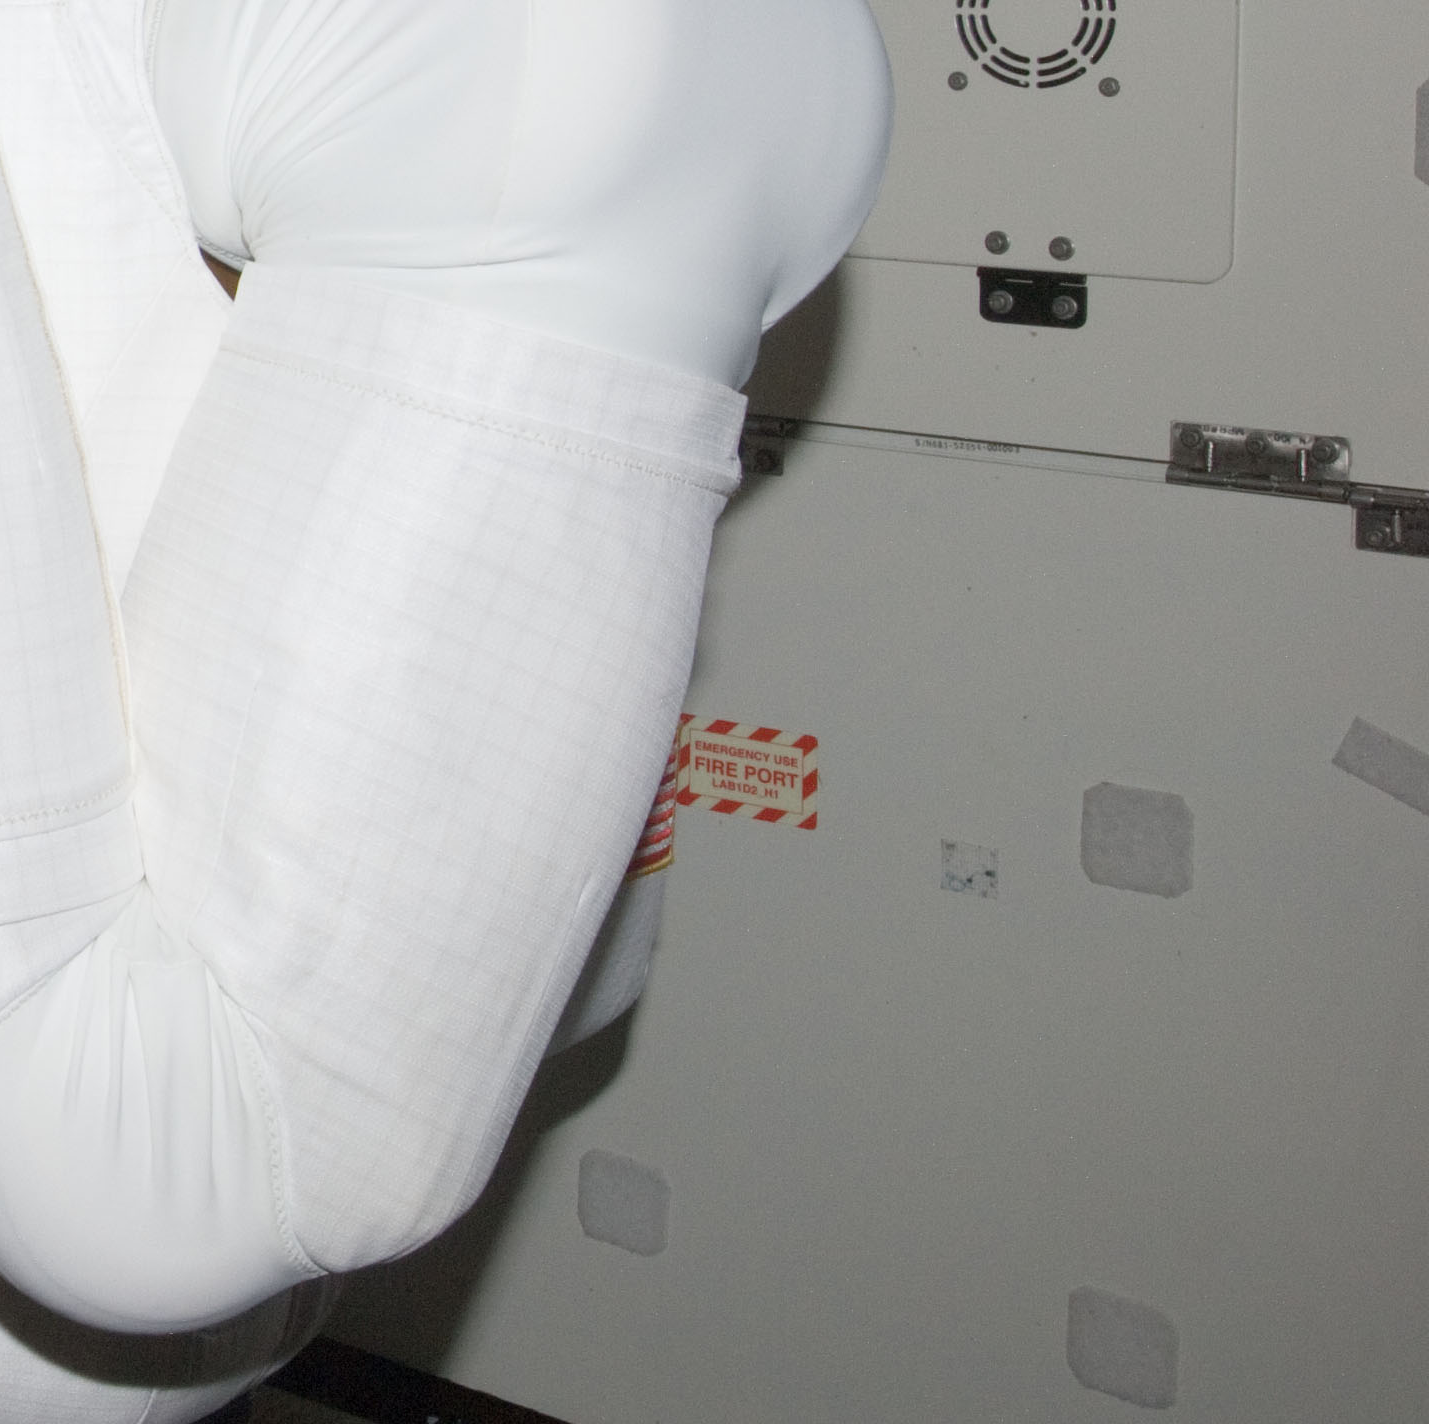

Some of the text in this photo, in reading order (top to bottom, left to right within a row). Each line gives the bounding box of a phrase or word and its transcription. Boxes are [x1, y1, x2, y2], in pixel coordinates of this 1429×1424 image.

[694, 740, 798, 768] EMERGENCY USE
[694, 756, 799, 789] FIRE PORT
